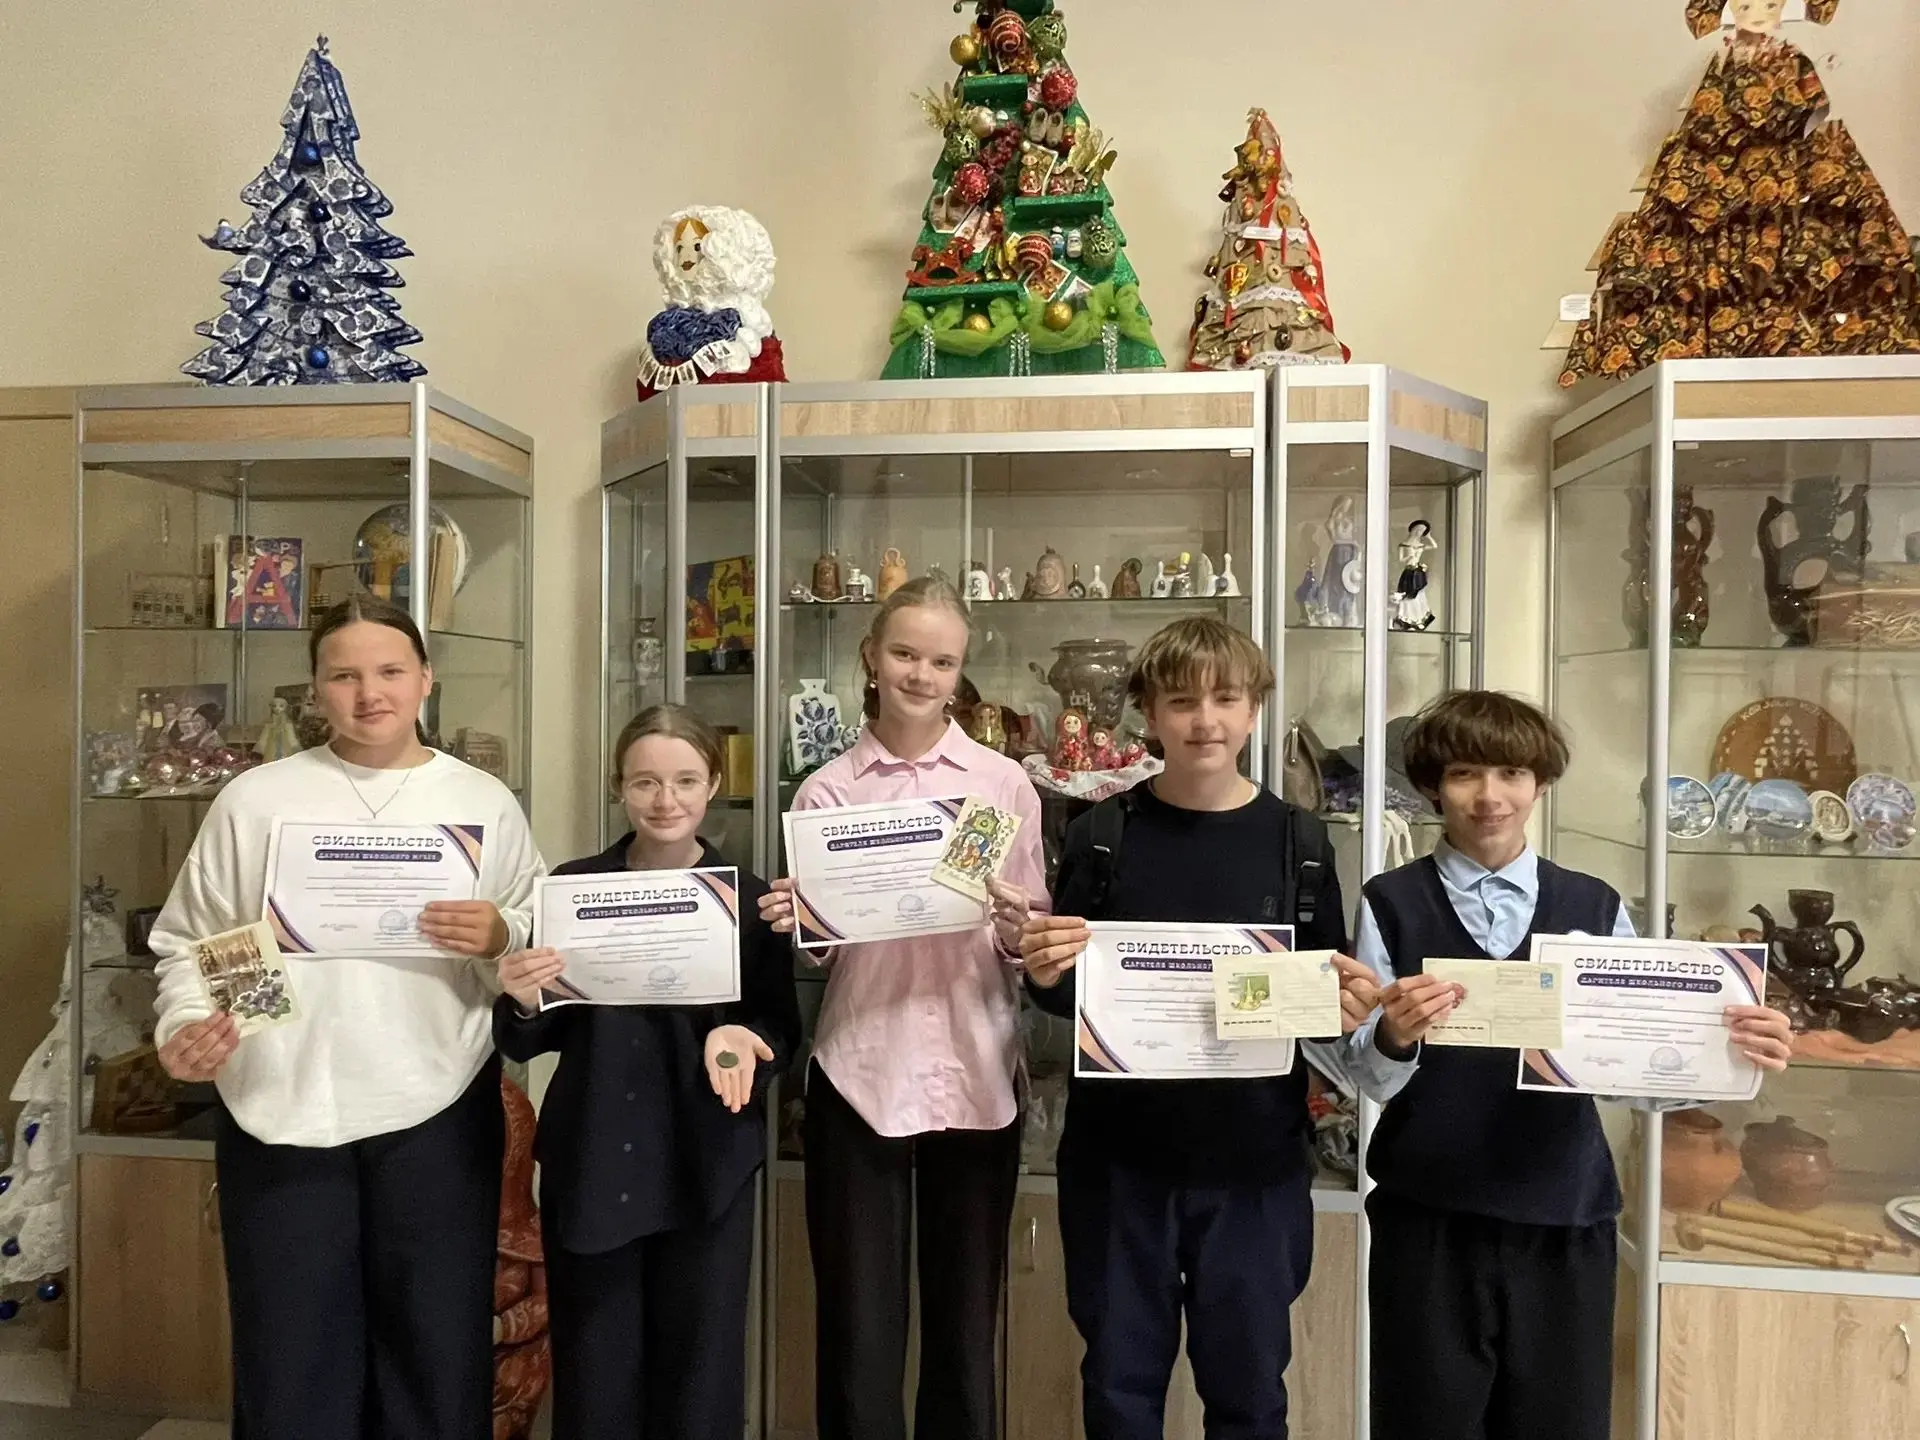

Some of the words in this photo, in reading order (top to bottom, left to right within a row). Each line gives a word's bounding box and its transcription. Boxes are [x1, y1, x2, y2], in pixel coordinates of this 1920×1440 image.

[821, 815, 943, 837] СВИДЕТЕЛЬСТВО
[312, 835, 445, 848] СВИДЕТЕЛЬСТВО
[572, 887, 700, 904] СВИДЕТЕЛЬСТВО
[1116, 942, 1253, 956] СВИДЕТЕЛЬСТВО
[1168, 962, 1213, 970] ШКОЛЬНОГ
[1574, 957, 1725, 976] СВИДЕТЕЛЬСТВО
